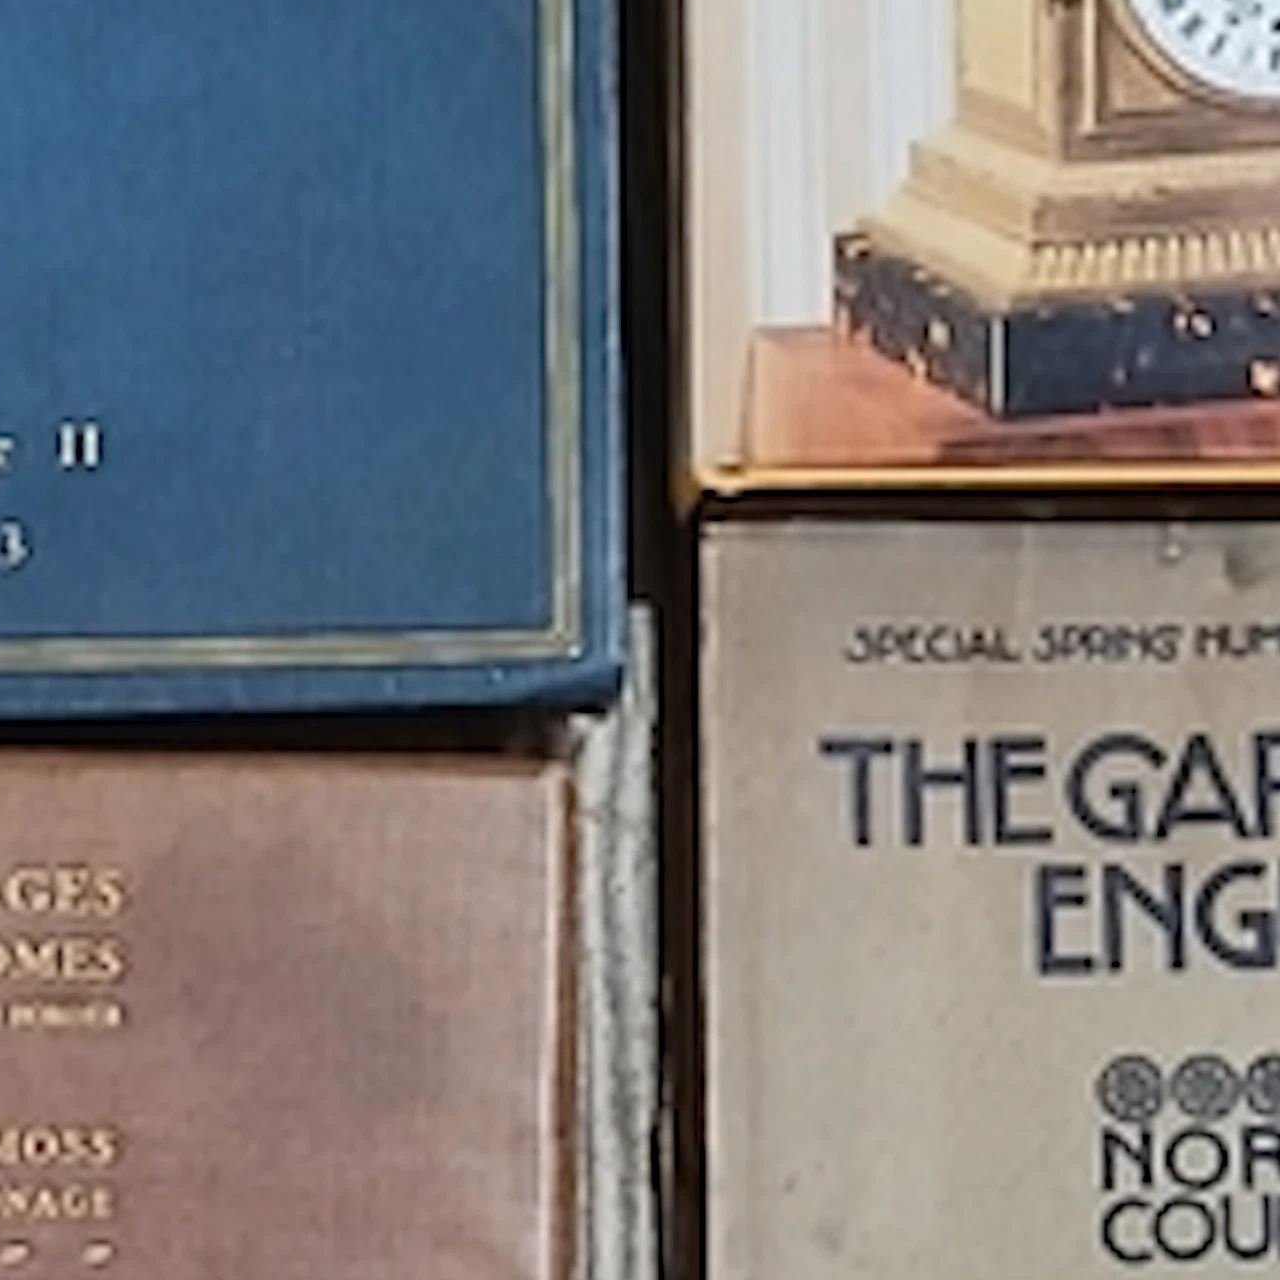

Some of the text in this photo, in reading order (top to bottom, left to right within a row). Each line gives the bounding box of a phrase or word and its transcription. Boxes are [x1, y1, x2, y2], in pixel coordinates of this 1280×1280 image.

[58, 420, 100, 468] II
[844, 623, 1022, 664] SPECIAL
[1032, 624, 1181, 663] SPRING
[820, 737, 1053, 845] THE
